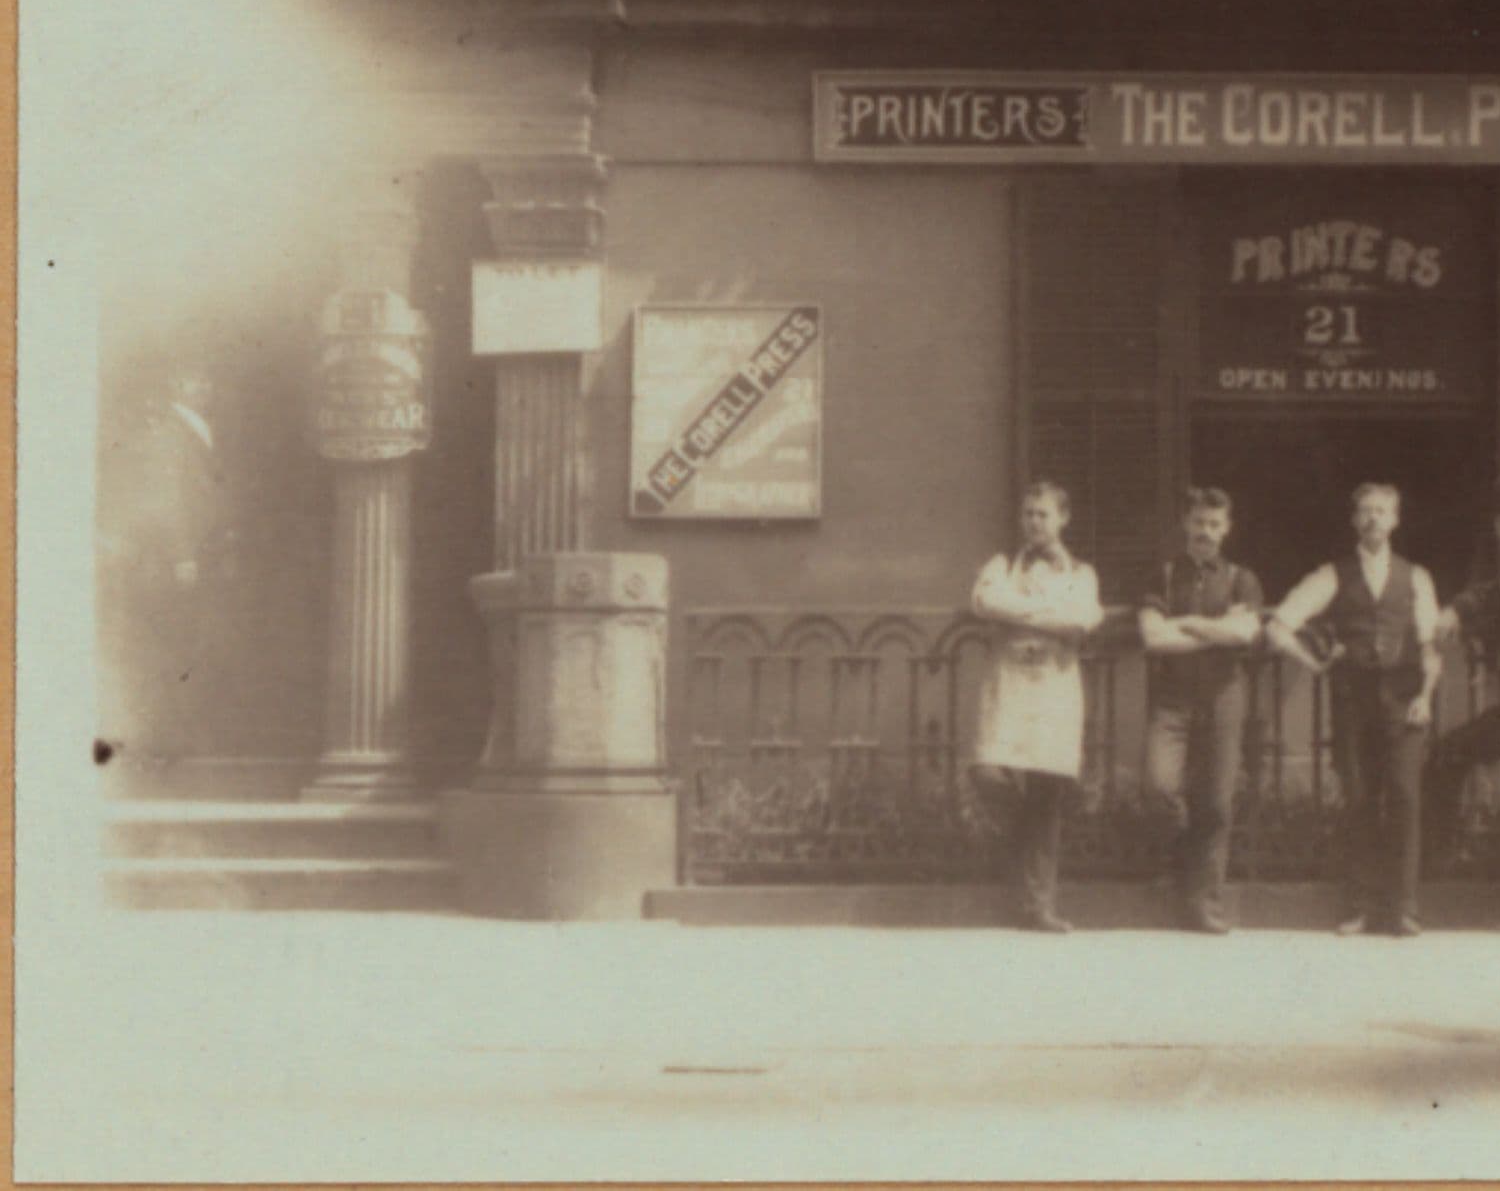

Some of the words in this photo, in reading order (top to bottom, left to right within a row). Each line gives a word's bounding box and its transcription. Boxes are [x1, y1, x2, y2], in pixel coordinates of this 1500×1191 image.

[852, 88, 1067, 144] PRINTERS
[1111, 82, 1207, 147] THE
[1230, 218, 1444, 290] PRINTERS
[1303, 304, 1364, 346] 21
[1217, 366, 1289, 392] OPEN
